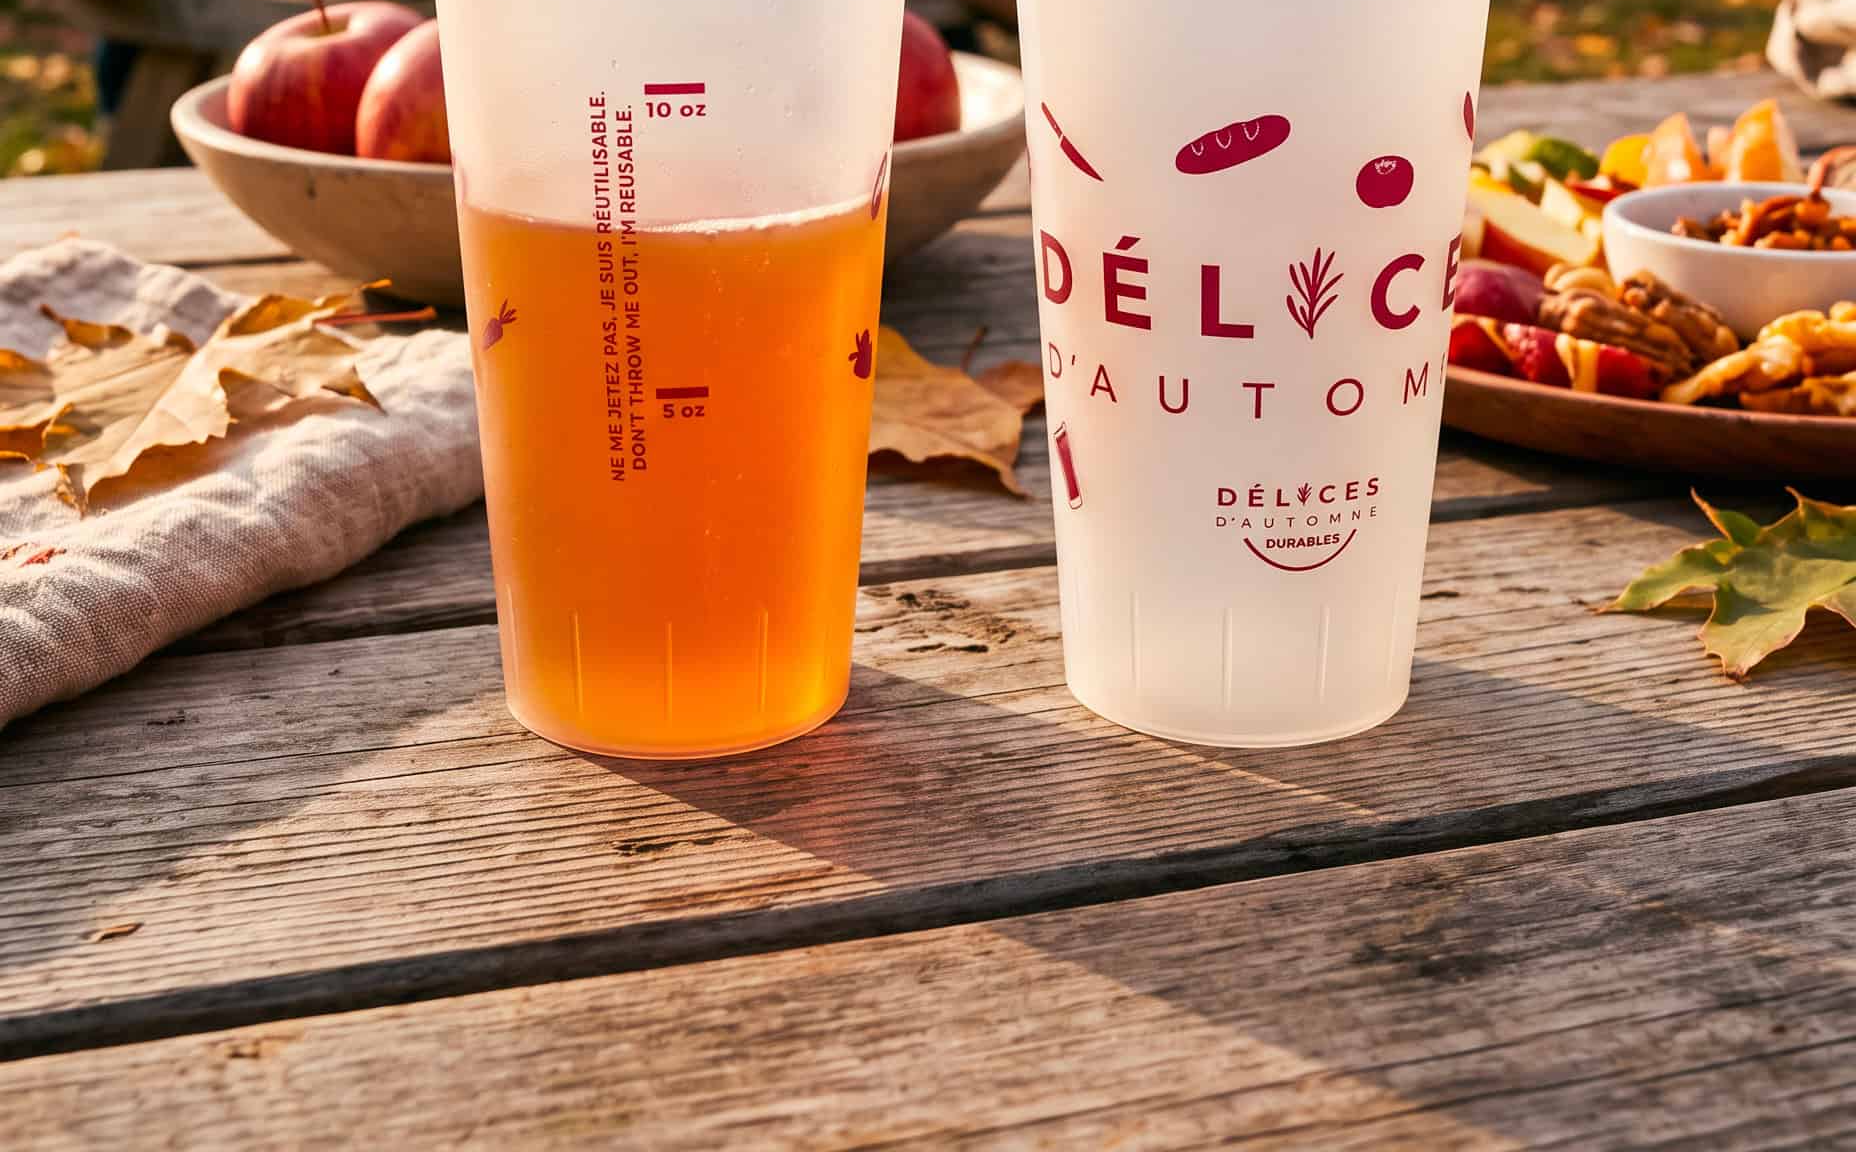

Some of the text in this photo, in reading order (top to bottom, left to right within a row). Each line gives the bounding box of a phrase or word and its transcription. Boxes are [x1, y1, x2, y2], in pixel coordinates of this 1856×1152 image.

[645, 102, 707, 118] 10 oz
[589, 91, 612, 234] RÉUTILISABLE.
[615, 105, 636, 214] REUSABLE.
[621, 220, 637, 245] I'M
[597, 241, 614, 283] SUIS
[600, 289, 616, 311] JE
[624, 301, 641, 329] ME
[626, 335, 645, 406] THROW
[1049, 341, 1446, 419] D'AUTOM
[605, 361, 622, 418] JETEZ
[663, 403, 705, 419] 5 oz
[608, 424, 624, 452] ME
[630, 412, 647, 470] DON'T
[610, 457, 625, 482] NE
[1216, 505, 1377, 529] D'AUTOMNE
[1266, 533, 1340, 549] DURABLES
